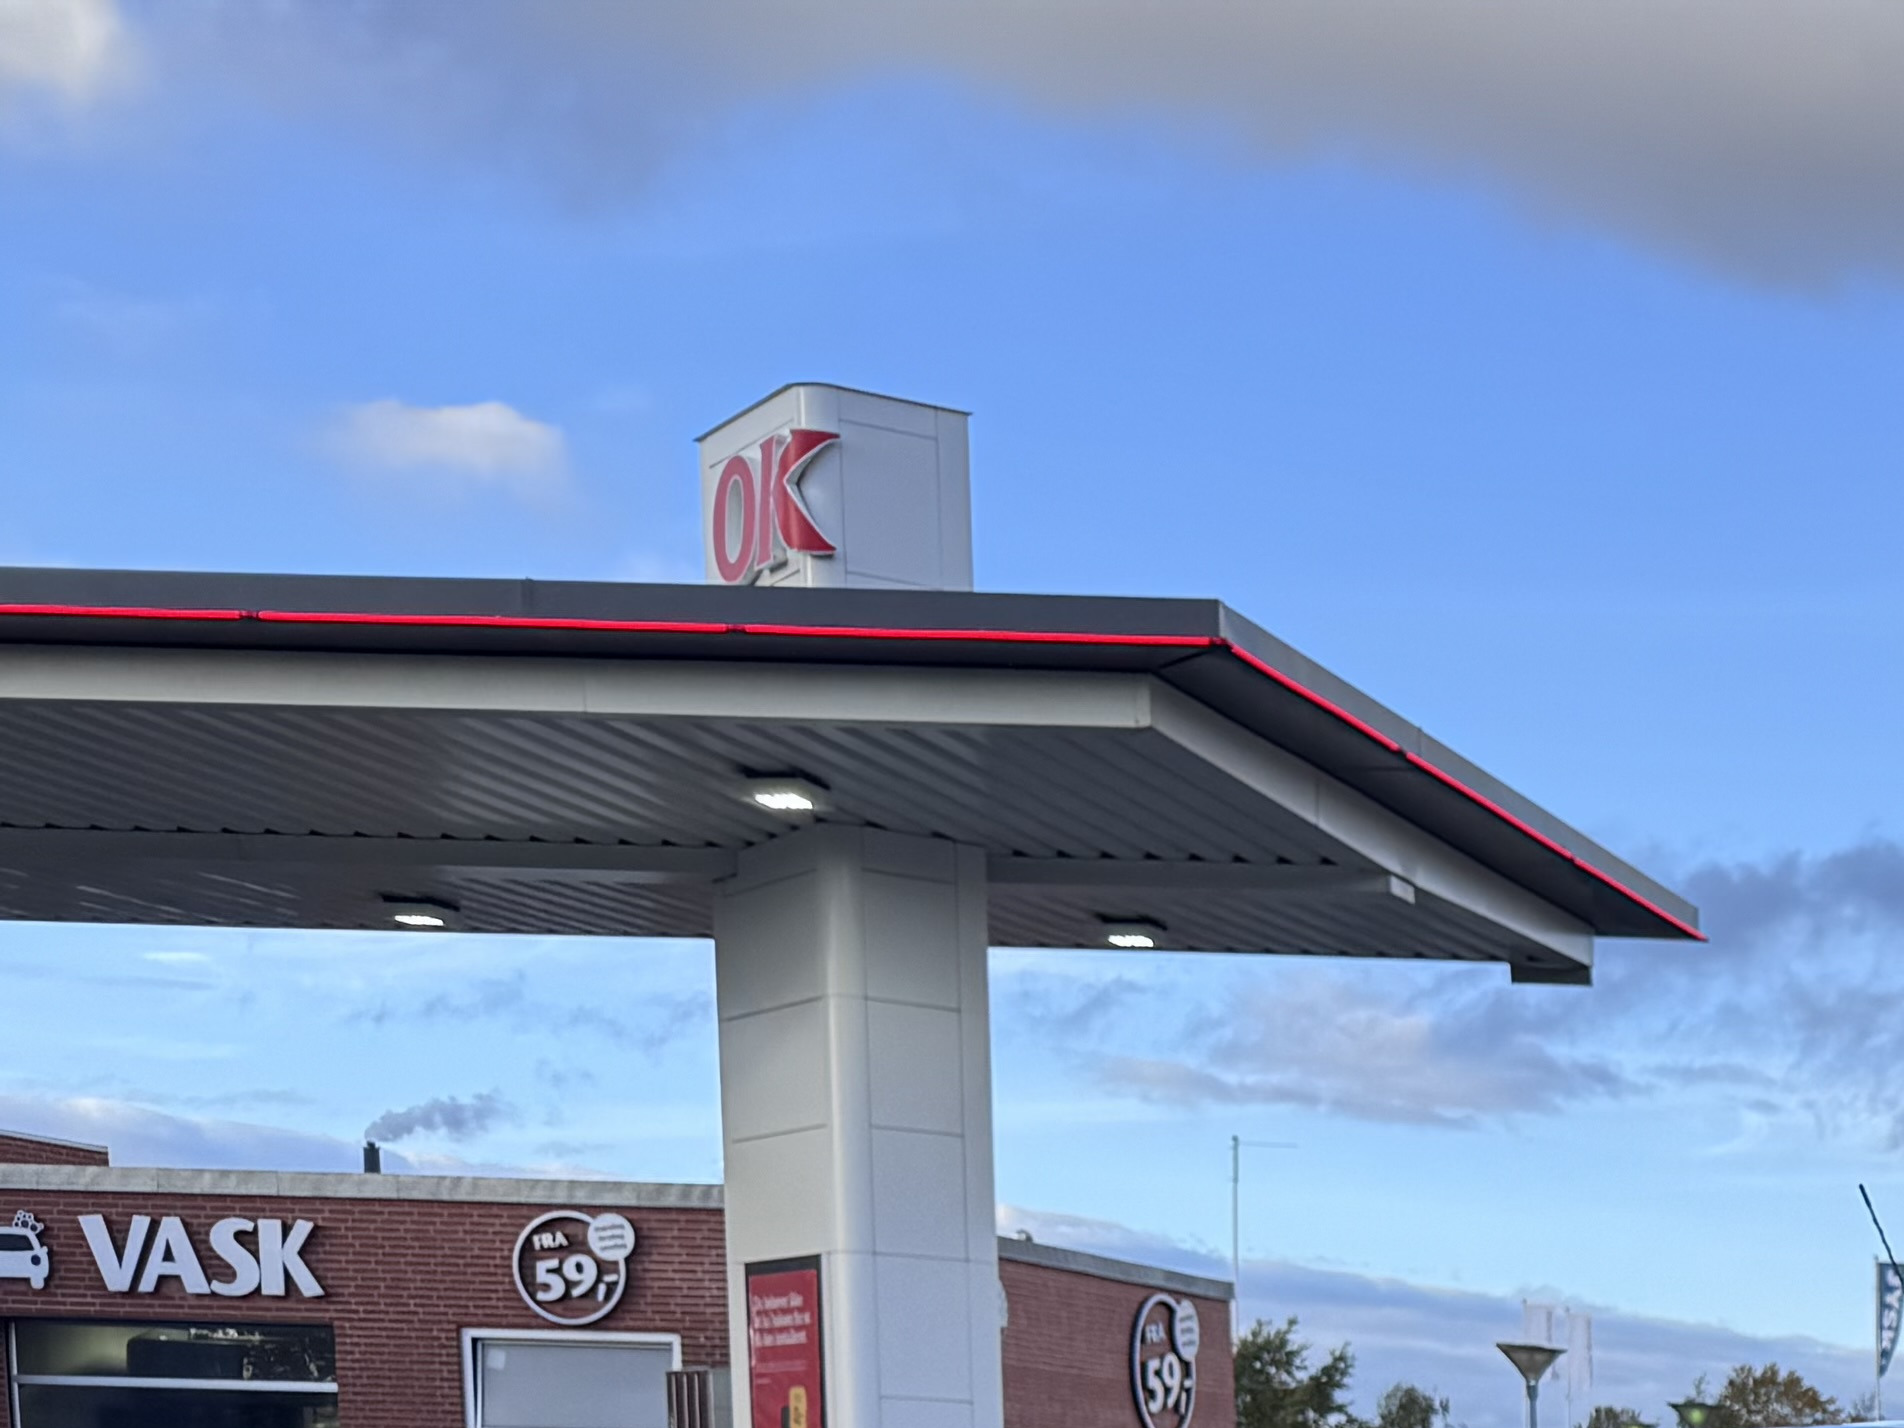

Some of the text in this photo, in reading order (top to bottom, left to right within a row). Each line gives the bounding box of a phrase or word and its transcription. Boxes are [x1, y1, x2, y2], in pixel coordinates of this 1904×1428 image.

[712, 428, 841, 584] OK
[77, 1213, 326, 1298] VASK
[532, 1231, 569, 1251] FRA
[1144, 1321, 1167, 1344] FRA
